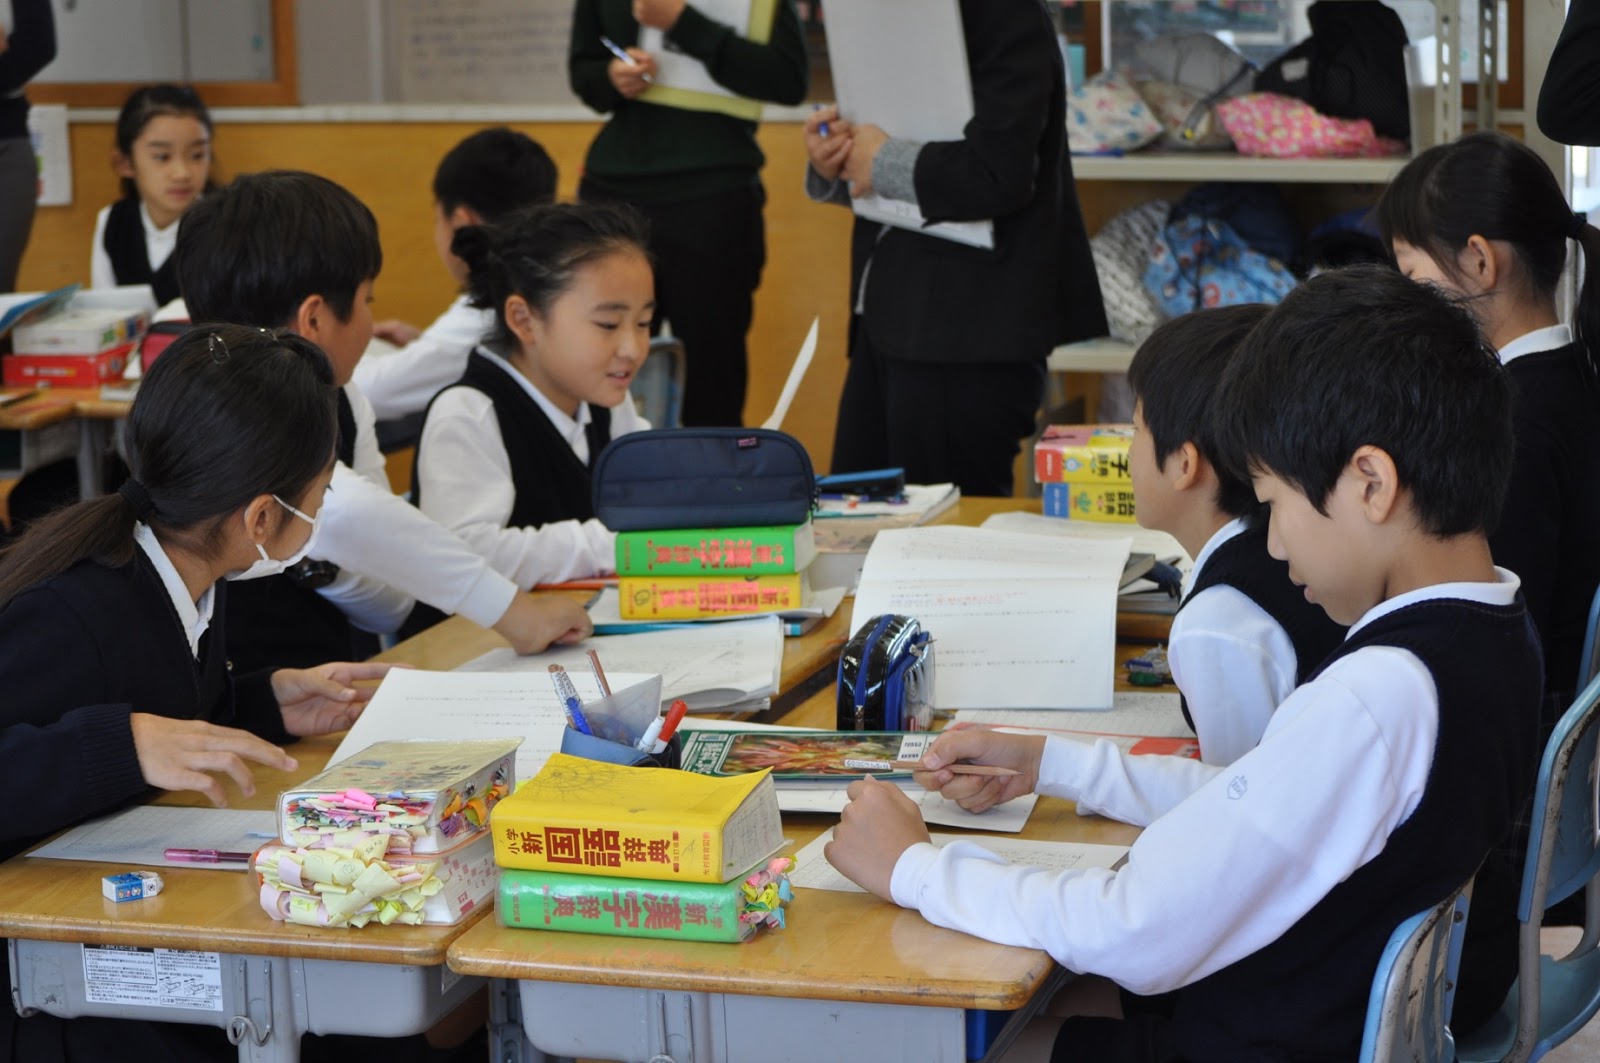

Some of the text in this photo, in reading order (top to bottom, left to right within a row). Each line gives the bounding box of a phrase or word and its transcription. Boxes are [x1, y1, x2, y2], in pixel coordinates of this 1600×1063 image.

[505, 828, 521, 855] 小学
[521, 826, 672, 868] 新国語辞典
[552, 889, 709, 931] 新漢字辞典
